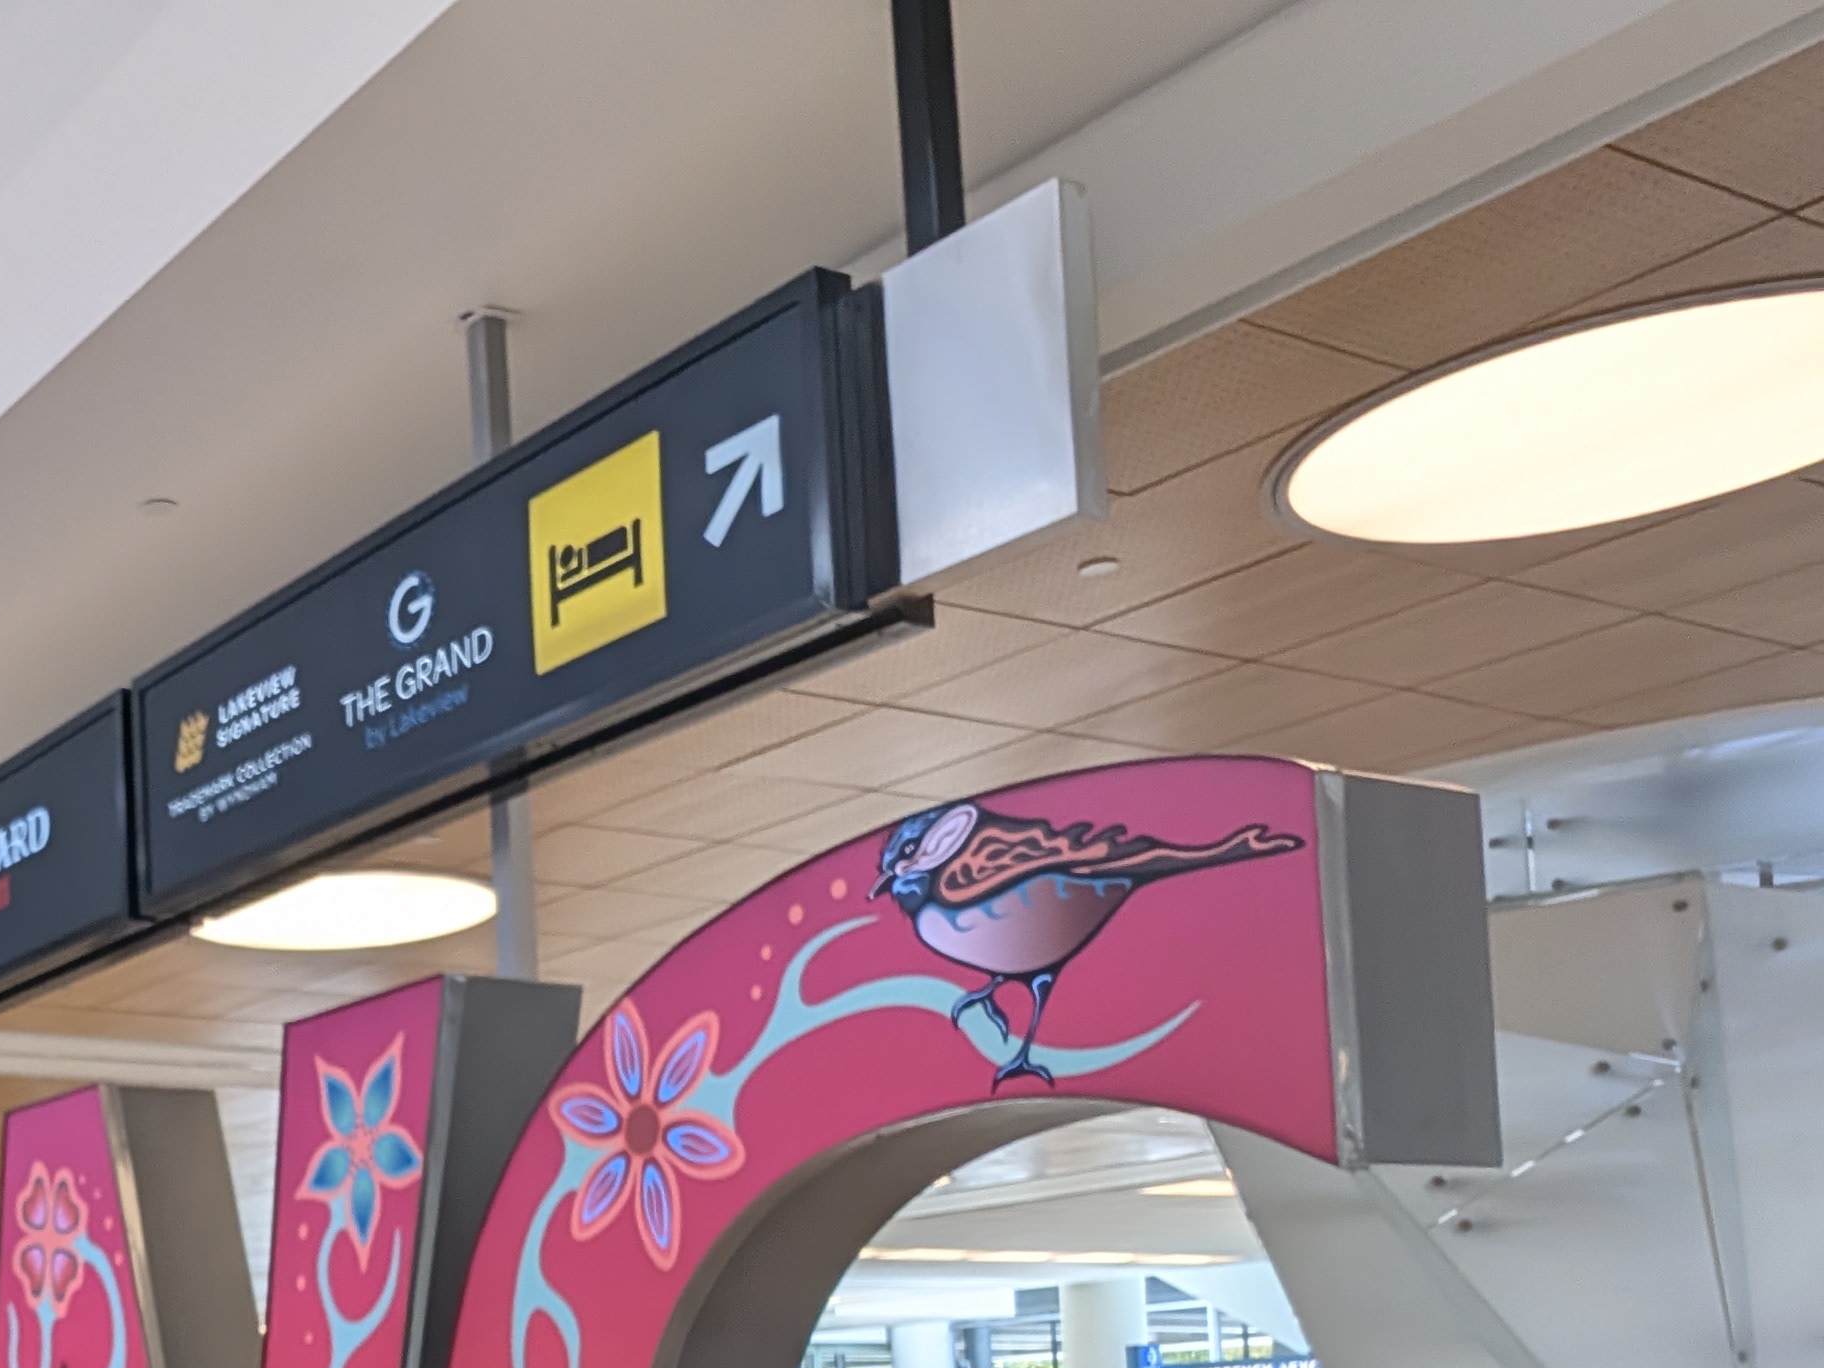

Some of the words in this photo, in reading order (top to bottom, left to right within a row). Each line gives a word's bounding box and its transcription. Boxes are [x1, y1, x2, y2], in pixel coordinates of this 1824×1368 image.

[217, 664, 297, 724] LAKEVIEW
[339, 674, 393, 728] THE
[395, 626, 494, 700] GRAND
[216, 686, 301, 748] SIGNATURE
[235, 731, 312, 783] COLLECTION
